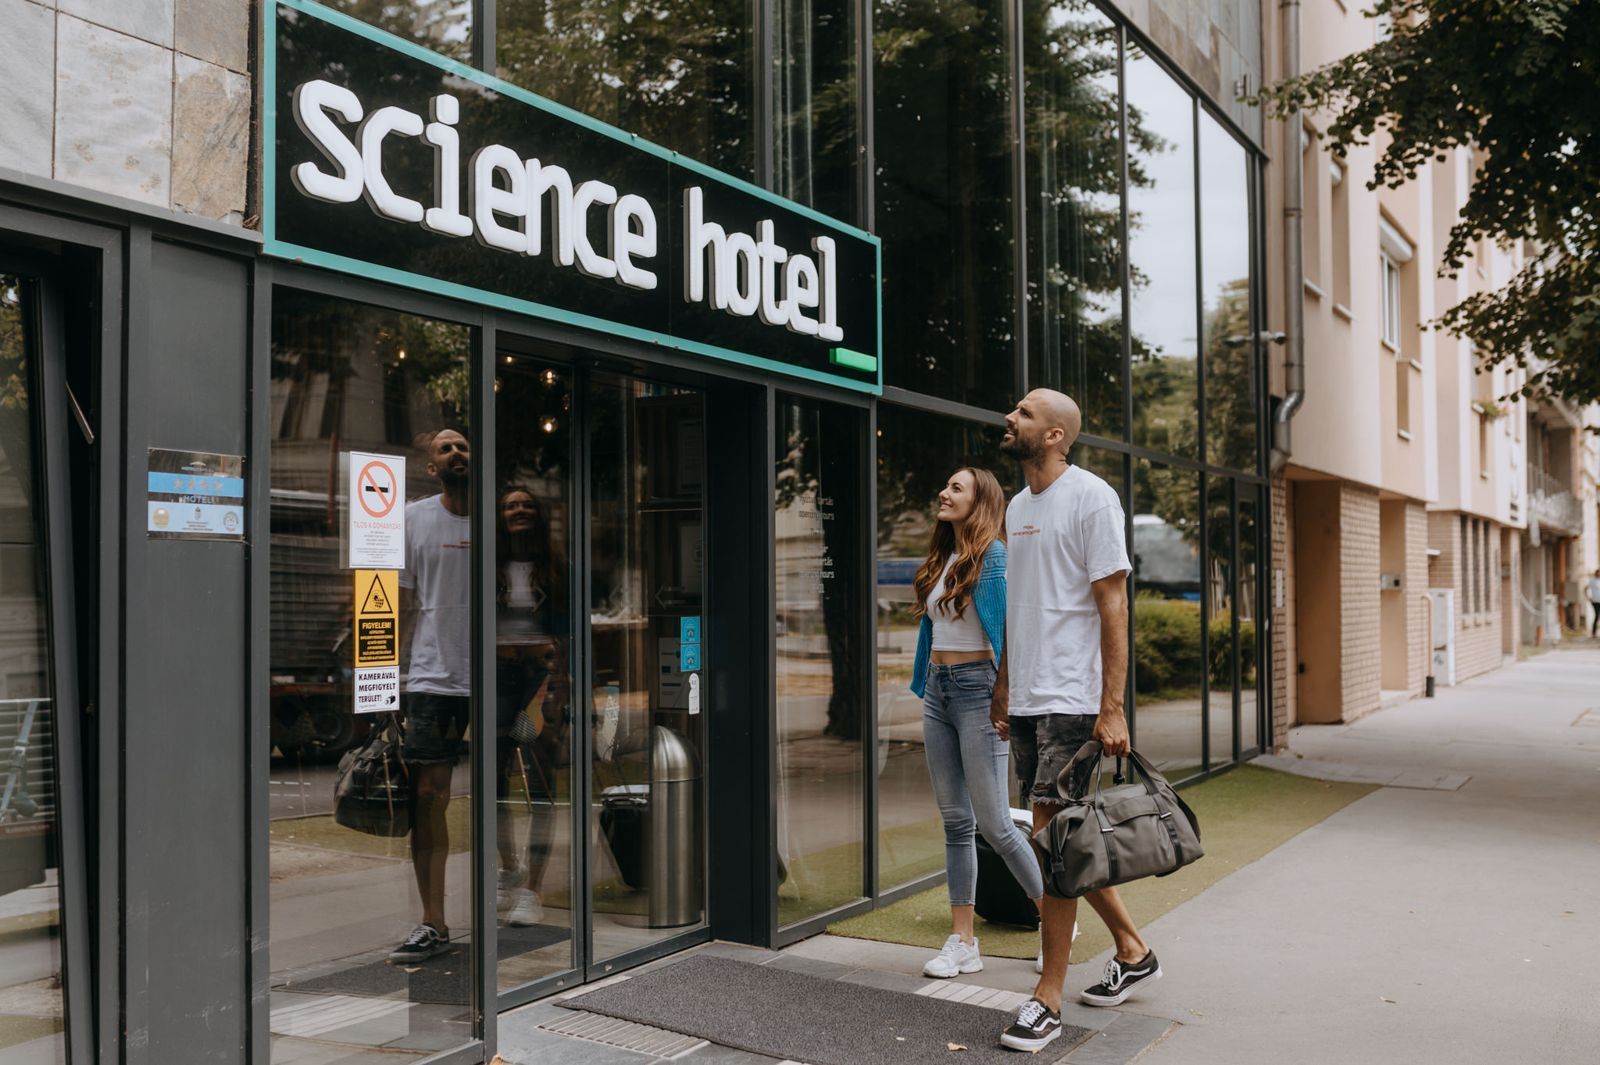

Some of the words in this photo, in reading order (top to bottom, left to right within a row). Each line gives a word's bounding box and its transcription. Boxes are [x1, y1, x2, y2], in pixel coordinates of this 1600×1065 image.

[291, 79, 658, 290] science
[683, 186, 844, 342] hotel
[358, 683, 396, 692] MEGFIGYELT
